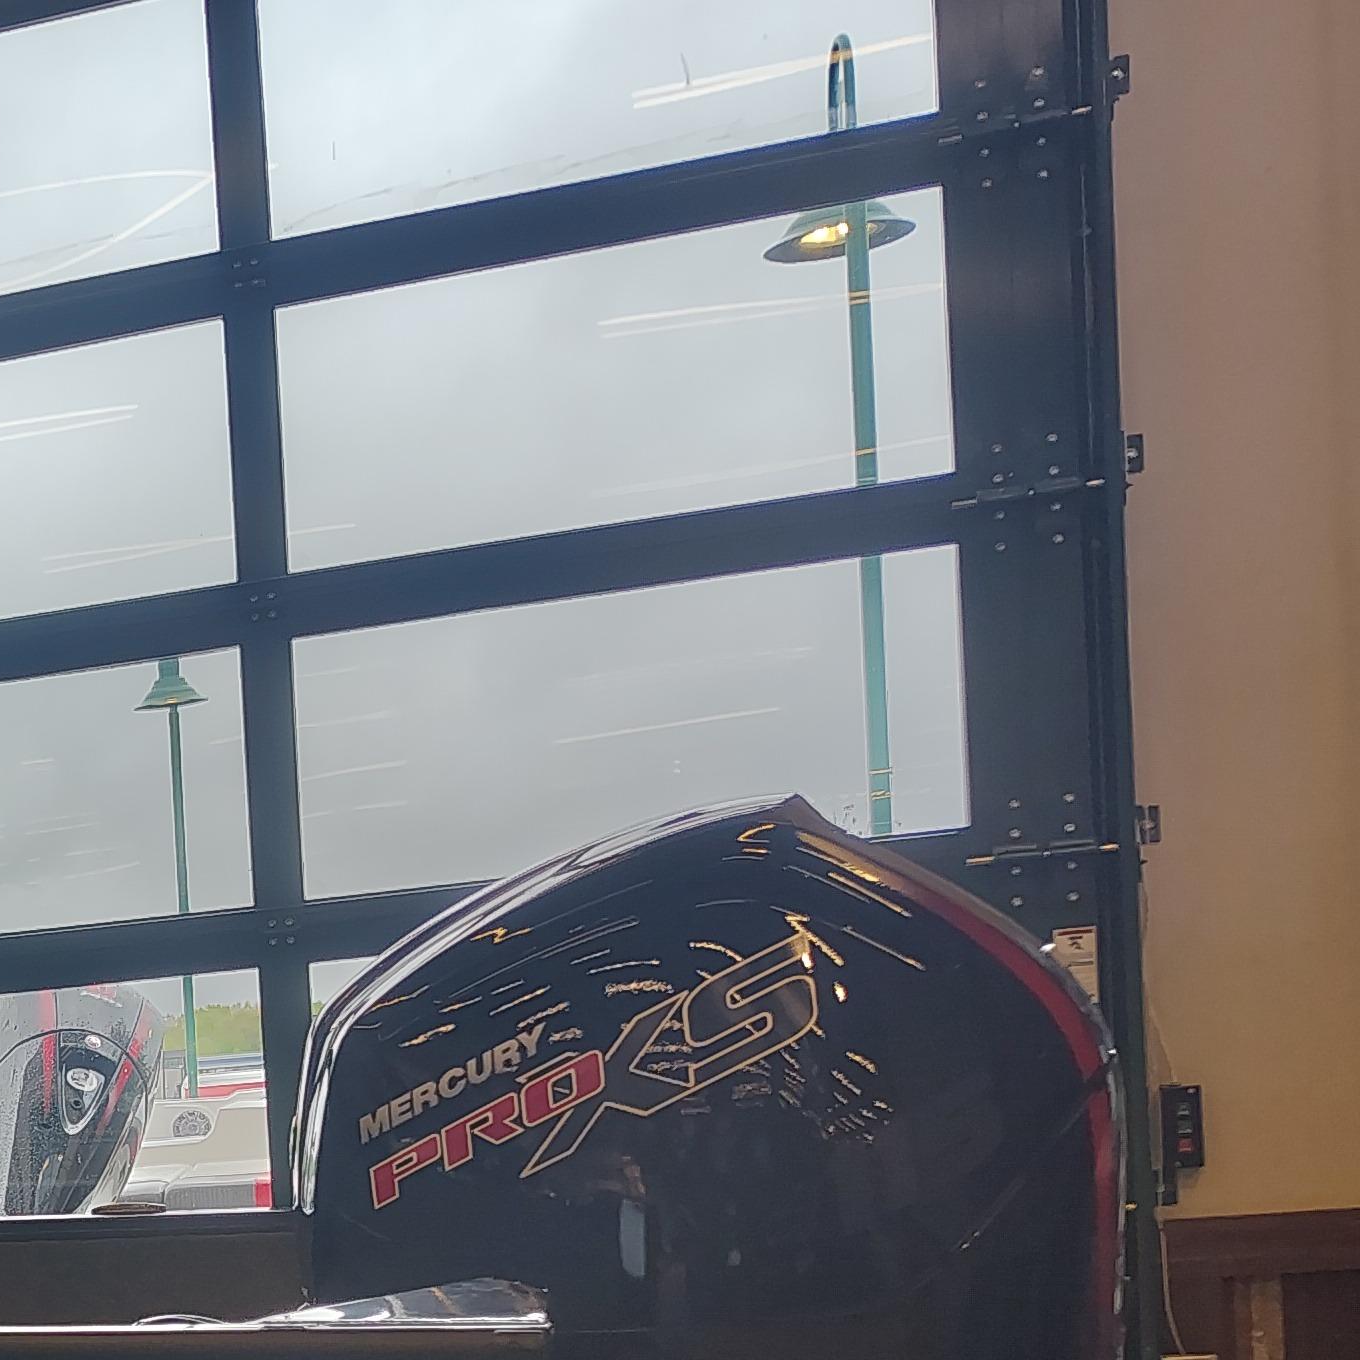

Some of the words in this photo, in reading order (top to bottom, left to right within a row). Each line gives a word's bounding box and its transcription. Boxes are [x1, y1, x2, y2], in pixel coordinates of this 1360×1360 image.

[358, 1022, 548, 1146] MERCURY
[368, 1048, 607, 1211] PRO
[517, 931, 821, 1180] XS
